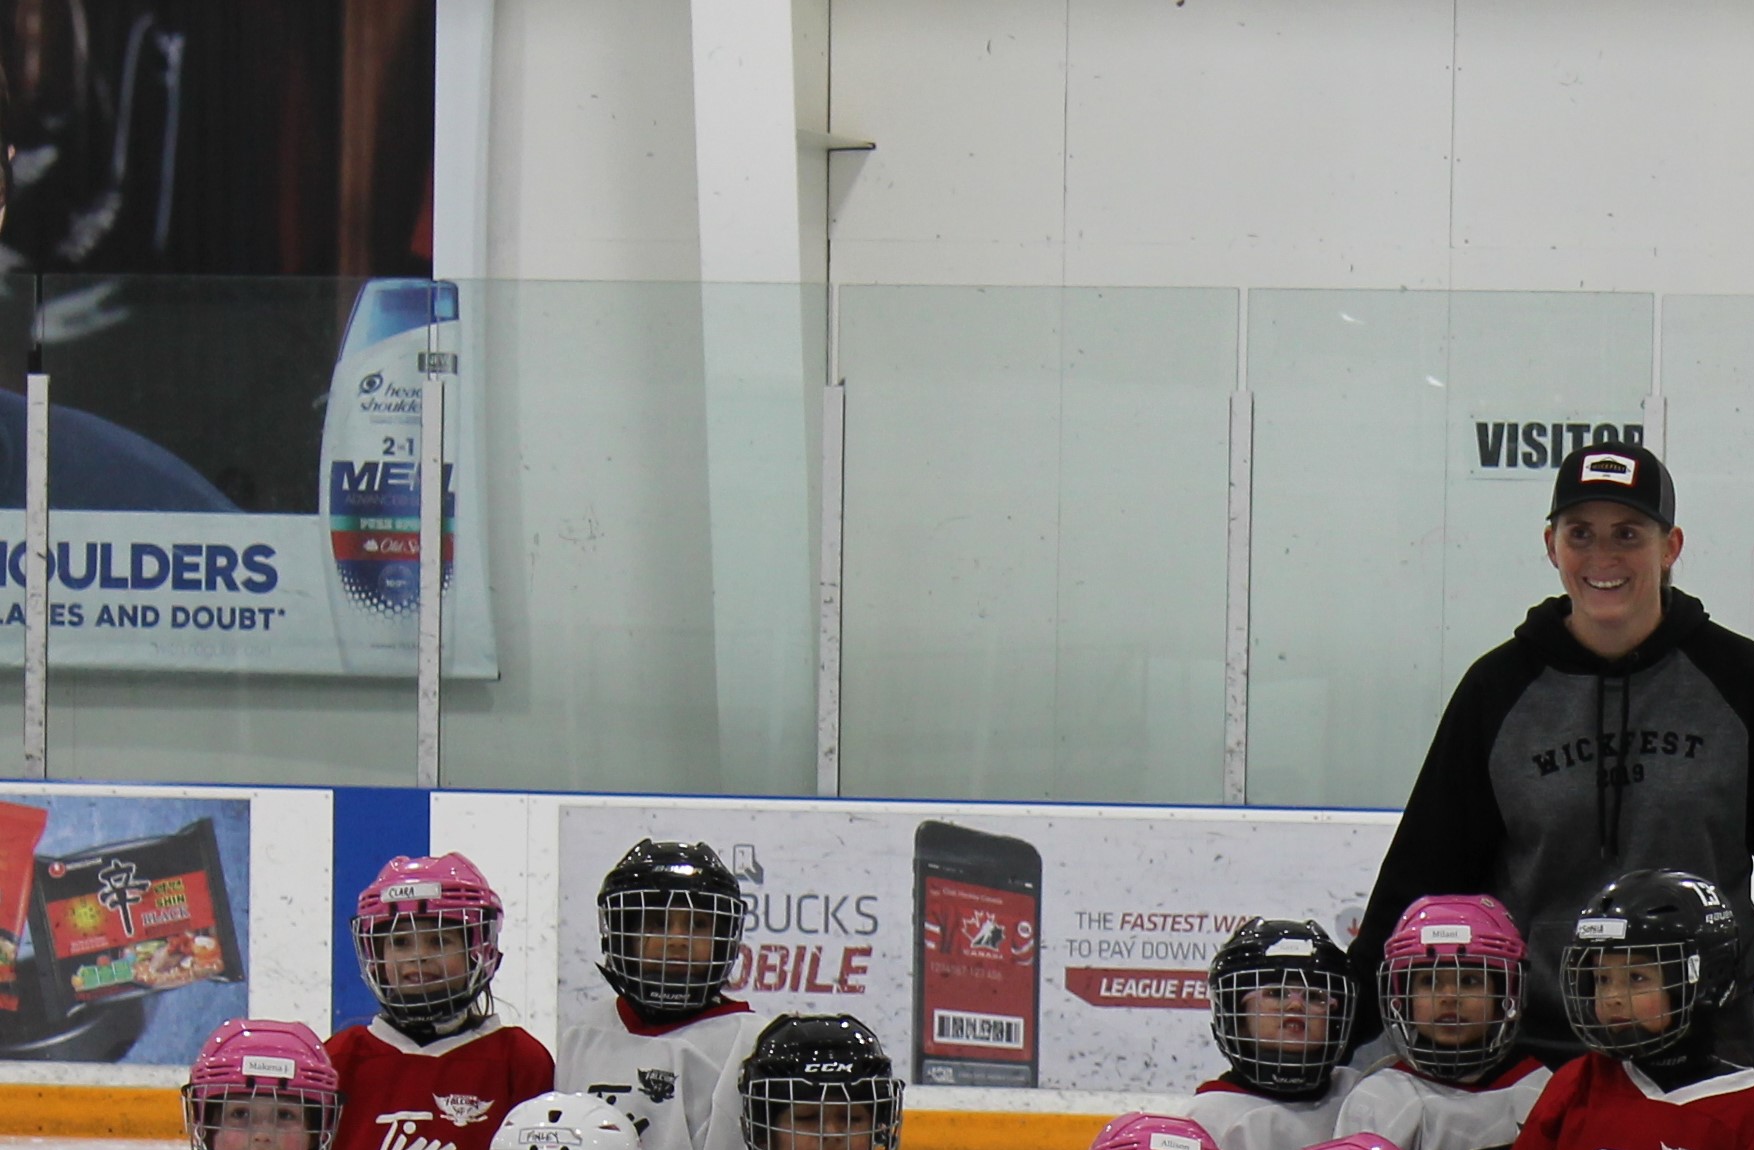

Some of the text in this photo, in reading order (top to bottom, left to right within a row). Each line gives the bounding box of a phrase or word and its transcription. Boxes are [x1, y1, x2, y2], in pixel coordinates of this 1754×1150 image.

[0, 541, 279, 594] OULDERS
[0, 603, 85, 627] AES
[95, 604, 160, 628] AND
[1532, 731, 1704, 776] WICKFEST
[156, 893, 187, 908] SHIN
[745, 893, 879, 935] BUCKS
[1075, 911, 1114, 931] THE
[1119, 912, 1208, 933] FASTEST
[1066, 939, 1096, 958] TO
[1099, 940, 1134, 960] PAY
[1141, 940, 1206, 959] DOWN
[1100, 976, 1177, 999] LEAGUE
[803, 1061, 855, 1074] CCM
